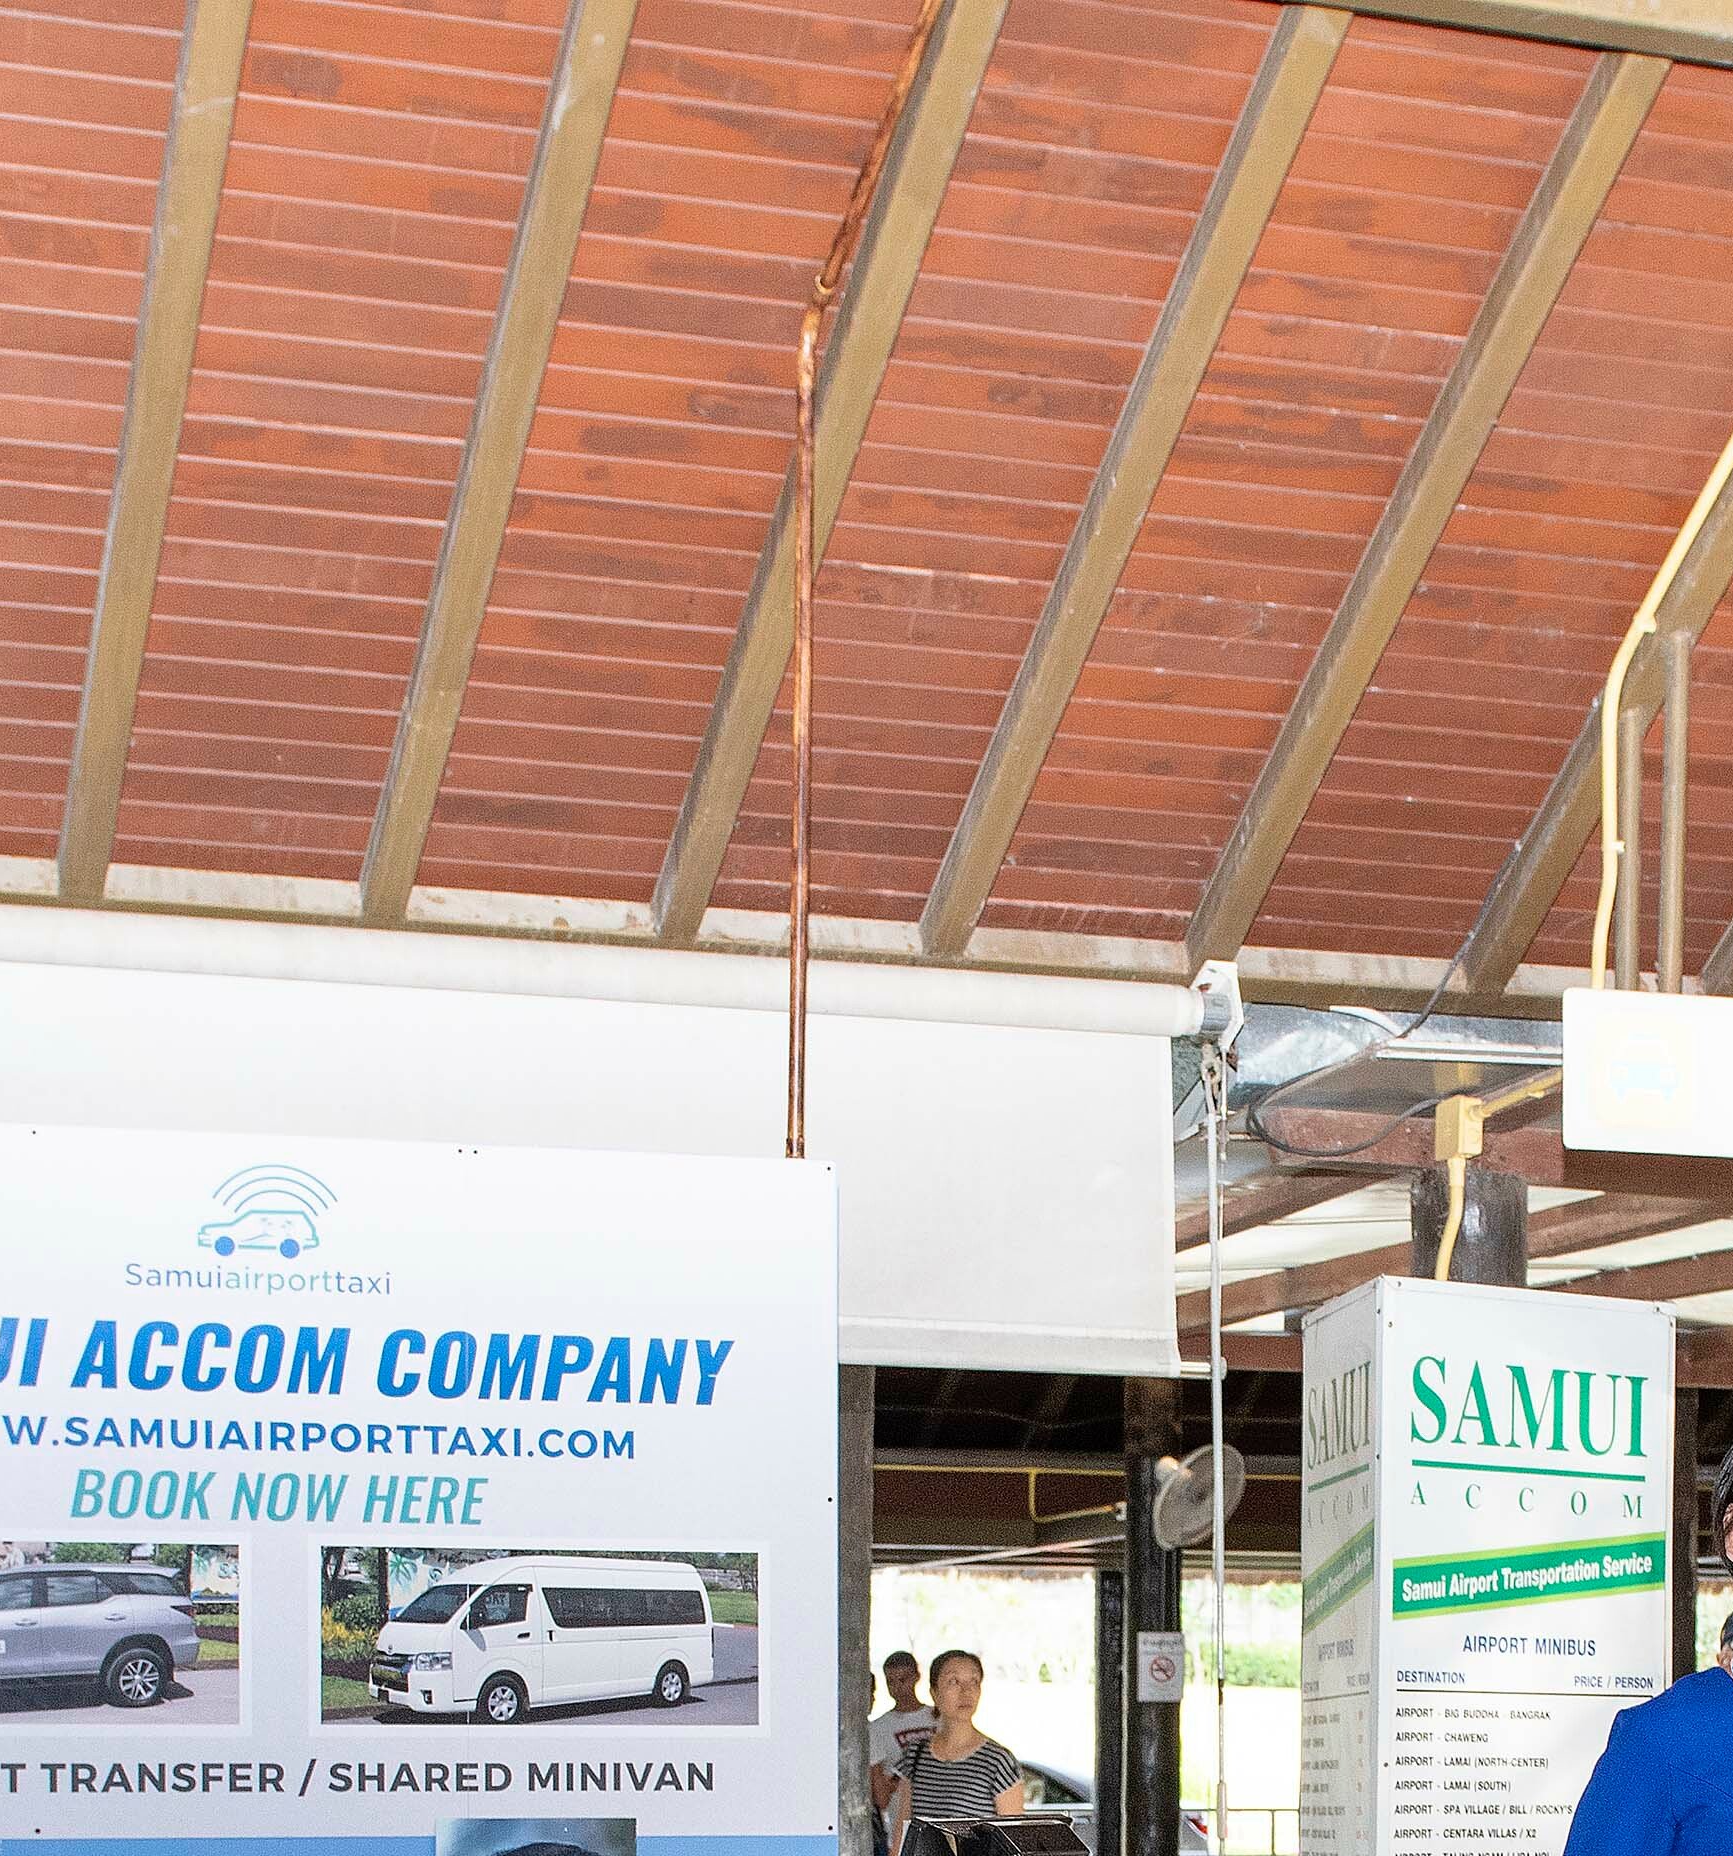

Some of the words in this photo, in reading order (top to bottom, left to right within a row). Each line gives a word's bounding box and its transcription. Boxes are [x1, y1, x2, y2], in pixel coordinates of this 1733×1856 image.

[124, 1262, 392, 1297] Samuiairporttaxi
[71, 1320, 351, 1397] ACCOM
[376, 1330, 735, 1406] COMPANY
[1308, 1361, 1371, 1470] SAMUI
[1410, 1355, 1649, 1458] SAMUI
[69, 1467, 214, 1521] BOOK
[230, 1471, 348, 1523] NOW
[360, 1475, 489, 1526] HERE
[1410, 1481, 1643, 1520] ACCOM
[1402, 1577, 1446, 1603] Samui
[1448, 1568, 1499, 1599] Airport
[1501, 1559, 1600, 1590] Transportation
[1602, 1552, 1652, 1576] Service
[1463, 1635, 1528, 1654] AIRPORT
[1535, 1638, 1596, 1657] MINIBUS
[1397, 1670, 1466, 1684] DESTINATION
[1574, 1676, 1603, 1688] PRICE
[1614, 1676, 1654, 1690] PERSON
[1395, 1707, 1434, 1718] AIRPORT
[1395, 1732, 1434, 1743] AIRPORT
[1395, 1756, 1434, 1767] AIRPORT
[1444, 1757, 1471, 1767] LAMAI
[40, 1762, 287, 1795] TRANSFER
[328, 1761, 512, 1794] SHARED
[527, 1761, 715, 1793] MINIVAN
[1395, 1780, 1433, 1791] AIRPORT
[1443, 1781, 1471, 1791] LAMAI
[1394, 1804, 1433, 1815] AIRPORT
[1443, 1804, 1461, 1814] SPA
[1463, 1804, 1500, 1815] VILLAGE
[1394, 1828, 1433, 1839] AIRPORT
[1443, 1828, 1484, 1838] CENTARA
[1487, 1828, 1517, 1838] VILLAS
